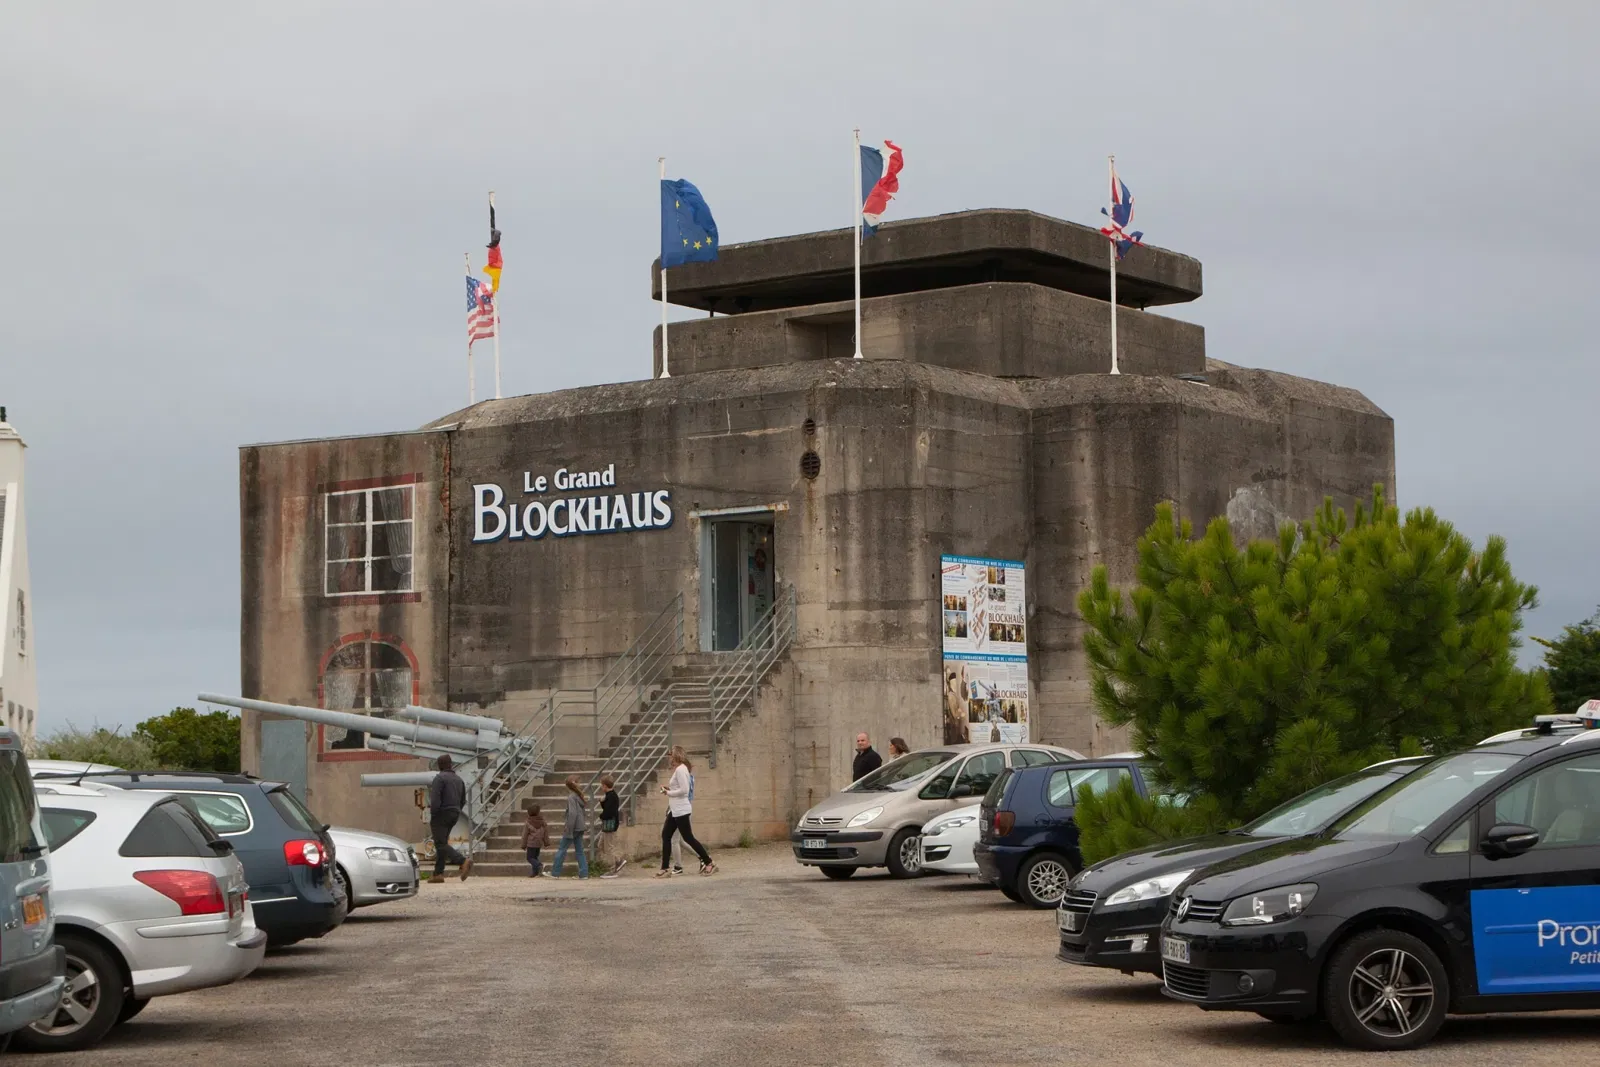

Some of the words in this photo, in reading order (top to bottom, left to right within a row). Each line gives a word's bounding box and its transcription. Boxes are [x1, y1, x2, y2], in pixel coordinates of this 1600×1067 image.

[523, 471, 547, 493] Le
[553, 464, 616, 491] Grand
[472, 484, 673, 543] BLOCKHAUS
[988, 612, 1024, 624] BLOCKHAUS
[994, 690, 1028, 699] BLOCKHAUS
